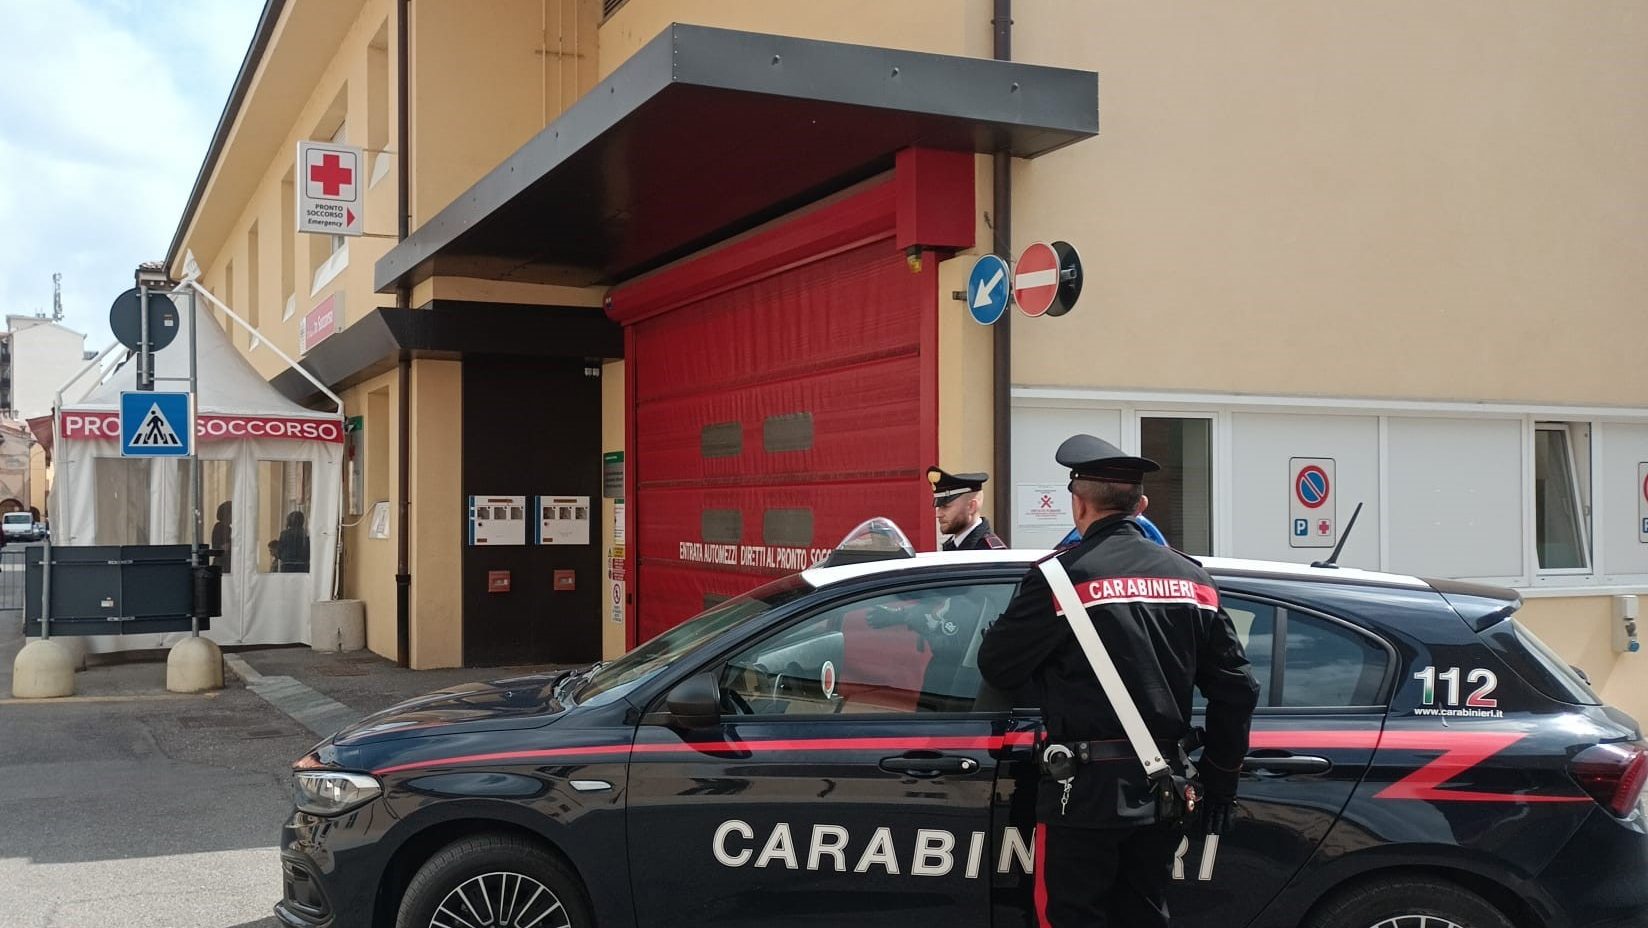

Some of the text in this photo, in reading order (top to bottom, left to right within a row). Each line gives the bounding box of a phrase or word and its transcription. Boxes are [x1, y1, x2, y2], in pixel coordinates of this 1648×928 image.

[307, 210, 343, 218] SOCCORSO
[308, 219, 343, 227] Emergency
[66, 416, 338, 440] PRO SOCCORSO
[1297, 521, 1306, 534] P
[680, 542, 703, 560] ENTRATA
[703, 544, 737, 564] AUTOMEZZI
[740, 546, 765, 566] DIRETTI
[766, 547, 775, 567] AL
[776, 548, 807, 570] PRONTO
[1089, 579, 1194, 599] CARABINIERI
[1414, 666, 1498, 707] 112
[1414, 708, 1504, 718] www.carabinieri.it
[713, 819, 1219, 880] CARABINI
